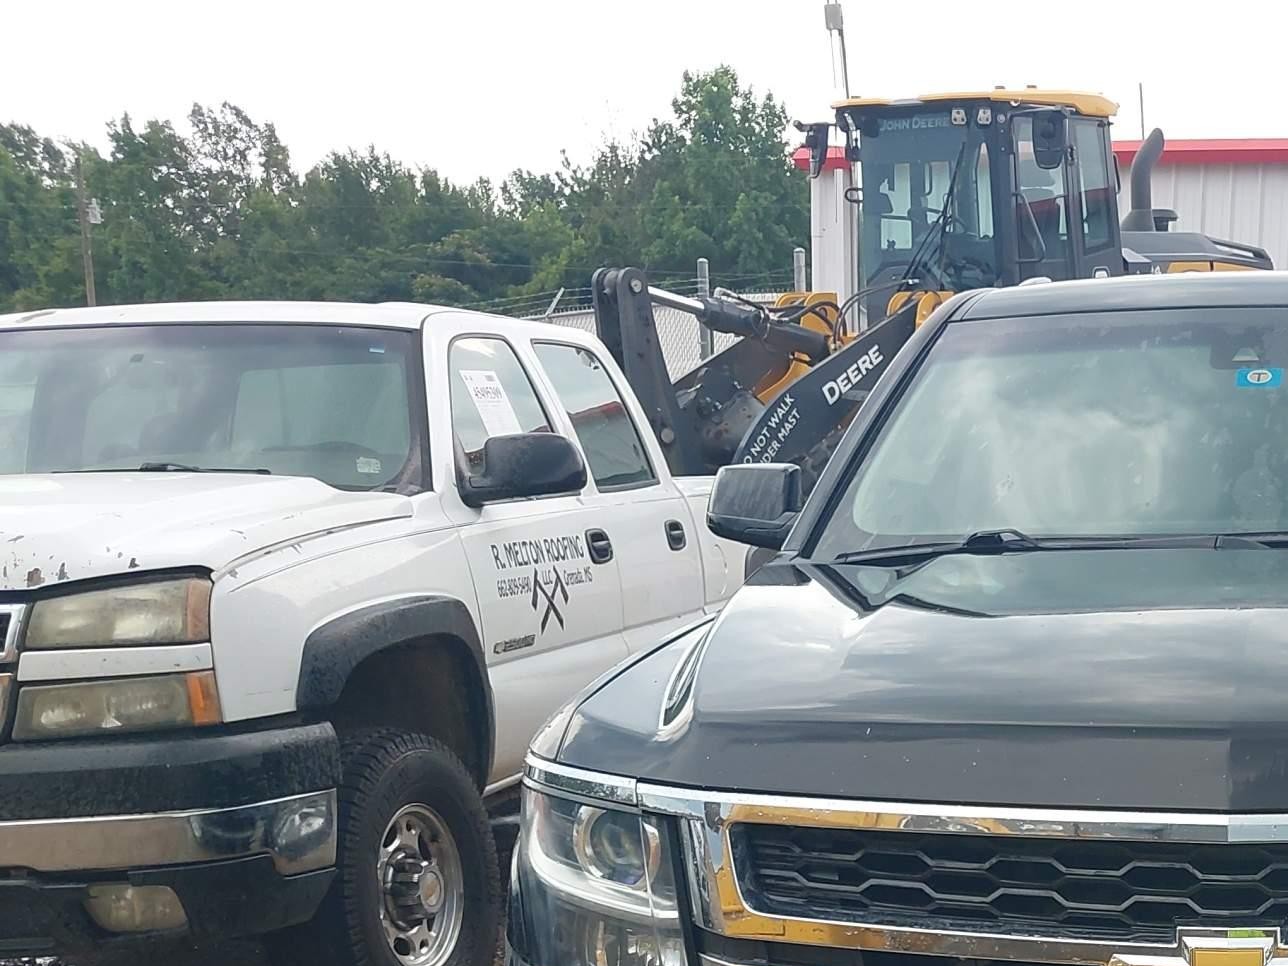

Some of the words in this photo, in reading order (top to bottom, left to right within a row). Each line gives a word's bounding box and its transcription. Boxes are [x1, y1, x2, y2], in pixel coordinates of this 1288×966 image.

[879, 119, 909, 131] JOHN
[821, 344, 883, 405] DEERE
[750, 426, 771, 456] NOT
[767, 393, 795, 429] WALK
[777, 408, 801, 441] MAST
[490, 544, 506, 569] R.
[503, 539, 546, 567] MELTON
[543, 535, 585, 561] ROOFING
